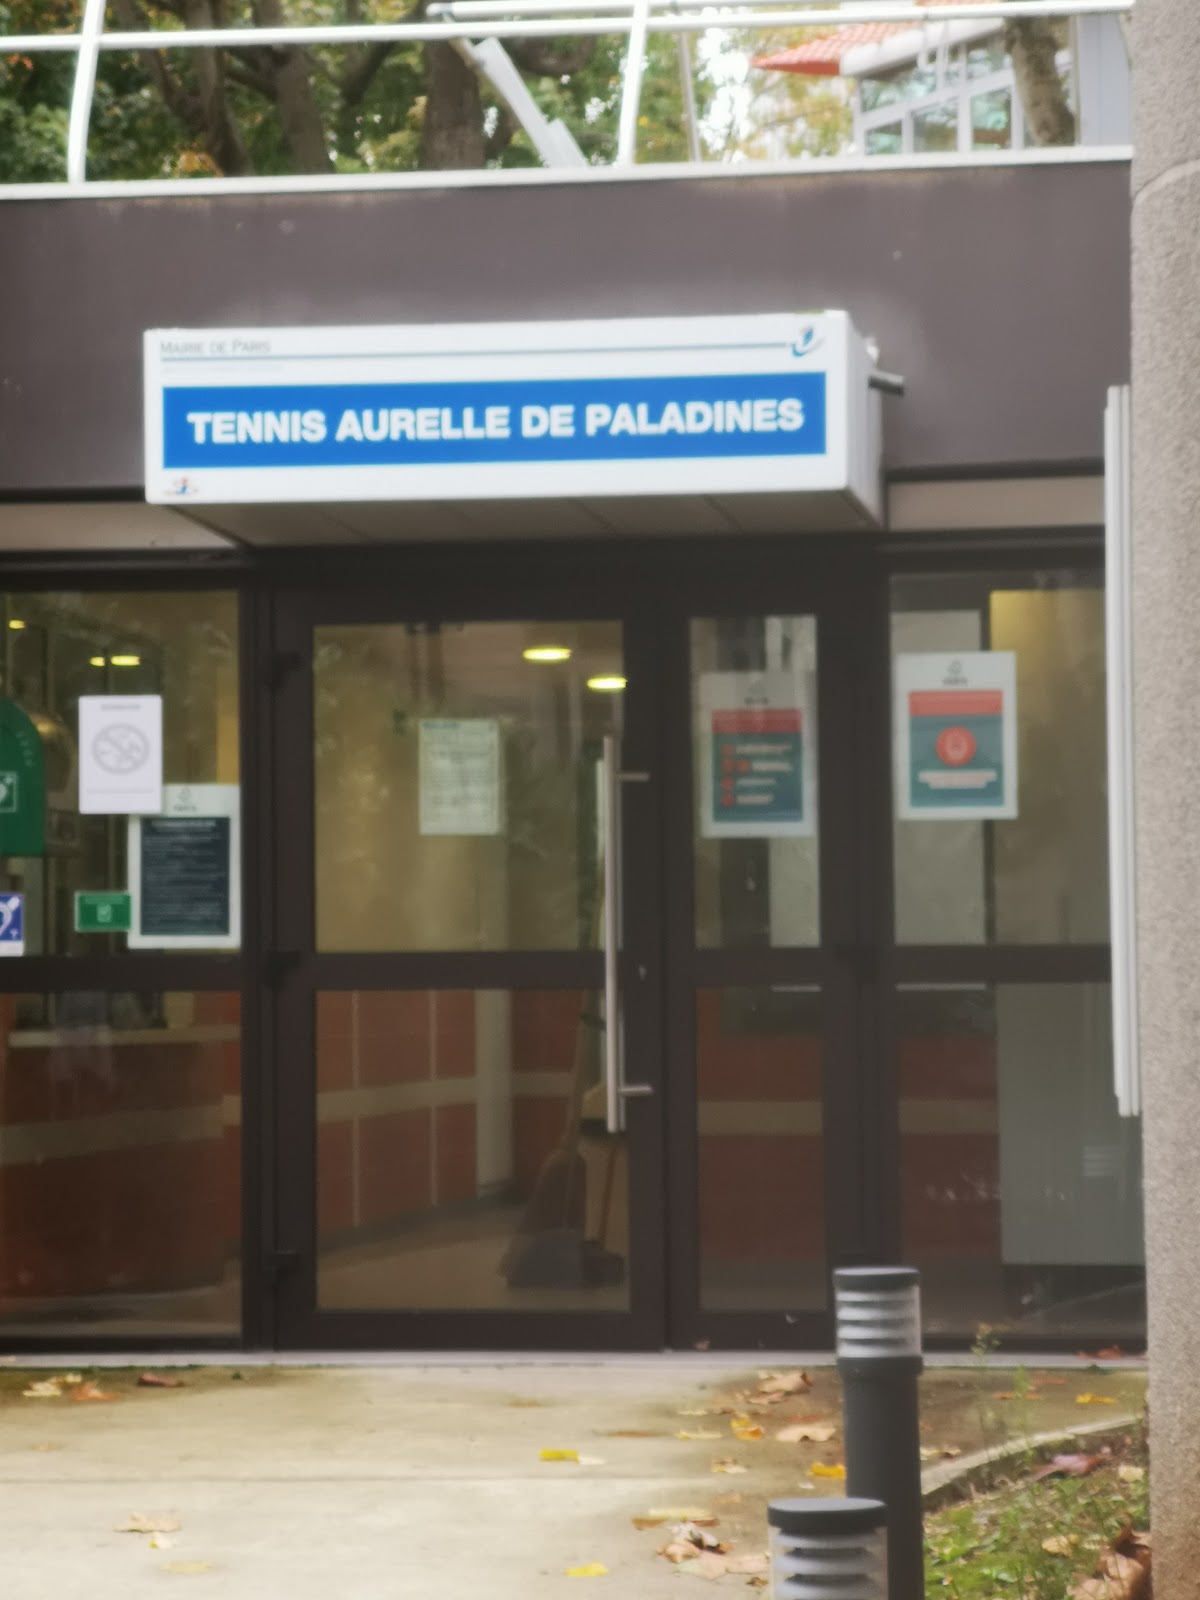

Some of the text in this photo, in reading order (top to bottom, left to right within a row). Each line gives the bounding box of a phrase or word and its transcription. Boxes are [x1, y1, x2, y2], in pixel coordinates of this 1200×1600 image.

[186, 397, 805, 444] TENNIS AURELLE DE PALADINES
